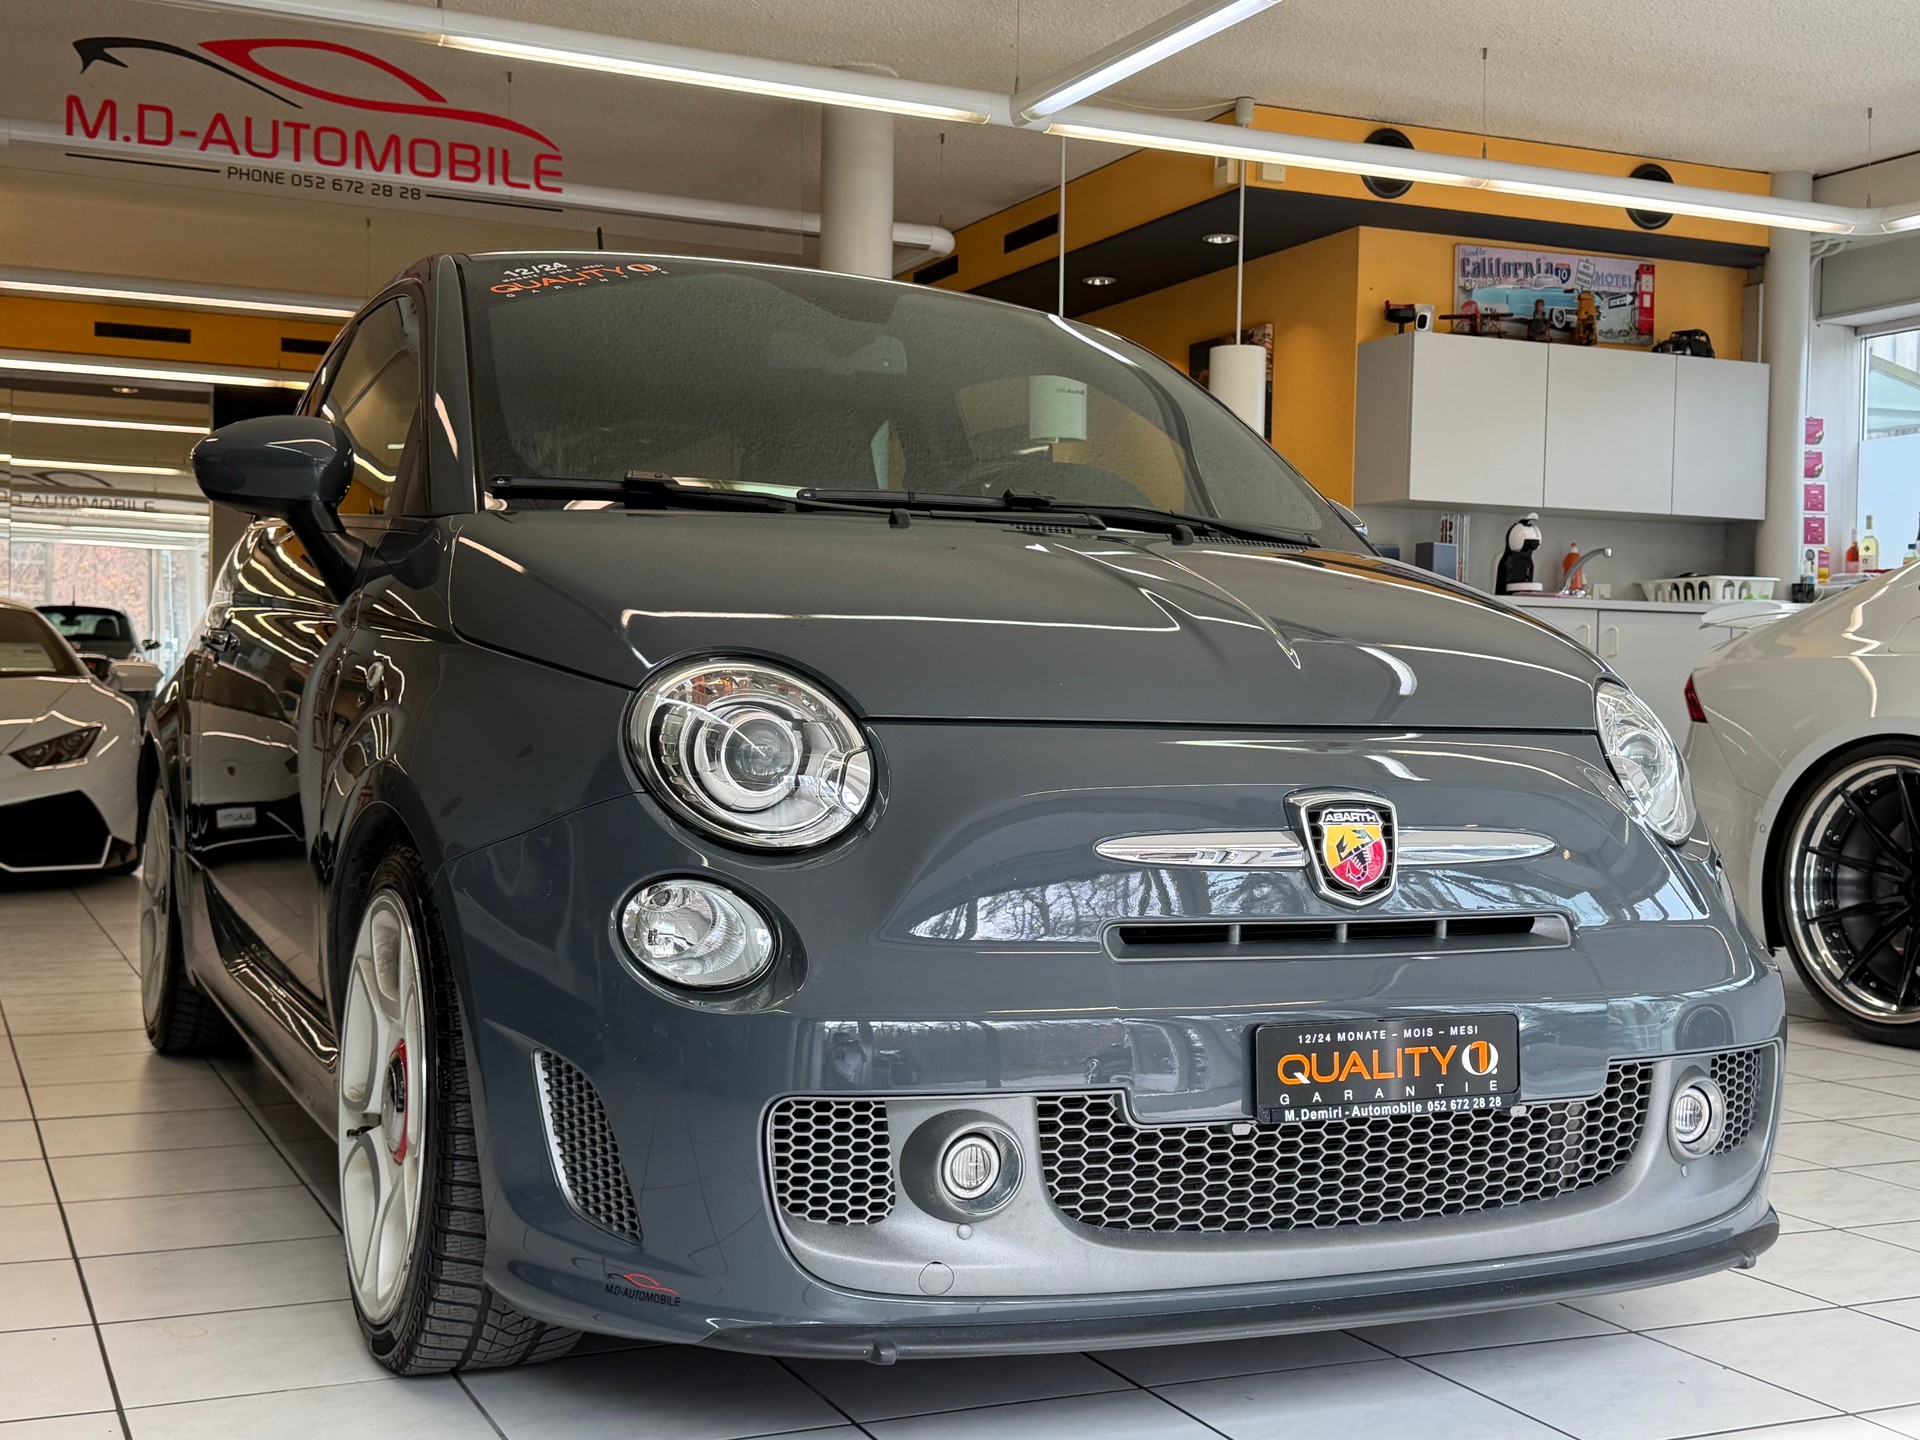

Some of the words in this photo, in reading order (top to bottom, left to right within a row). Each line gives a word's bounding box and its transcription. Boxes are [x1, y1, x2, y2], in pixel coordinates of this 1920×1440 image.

[66, 94, 563, 194] M.D-AUTOMOBILE
[227, 166, 285, 185] PHONE
[291, 174, 325, 189] 052
[332, 178, 364, 194] 672
[371, 183, 393, 198] 28
[399, 186, 421, 200] 28
[503, 262, 568, 277] 12/24
[1461, 257, 1554, 279] California
[1558, 269, 1568, 283] 10
[490, 266, 624, 294] QUALITY
[1593, 271, 1635, 289] MOTEL
[1325, 812, 1376, 822] ABARTH
[1298, 1033, 1332, 1044] 12/24
[1337, 1030, 1387, 1042] MONATE
[1403, 1028, 1433, 1038] MOIS
[1450, 1025, 1479, 1036] MESI
[1277, 1044, 1458, 1086] QUALITY
[1279, 1080, 1498, 1106] GARANTIE
[1427, 1100, 1447, 1112] 052
[1450, 1099, 1470, 1110] 672
[1473, 1097, 1486, 1109] 28
[1489, 1096, 1502, 1108] 28
